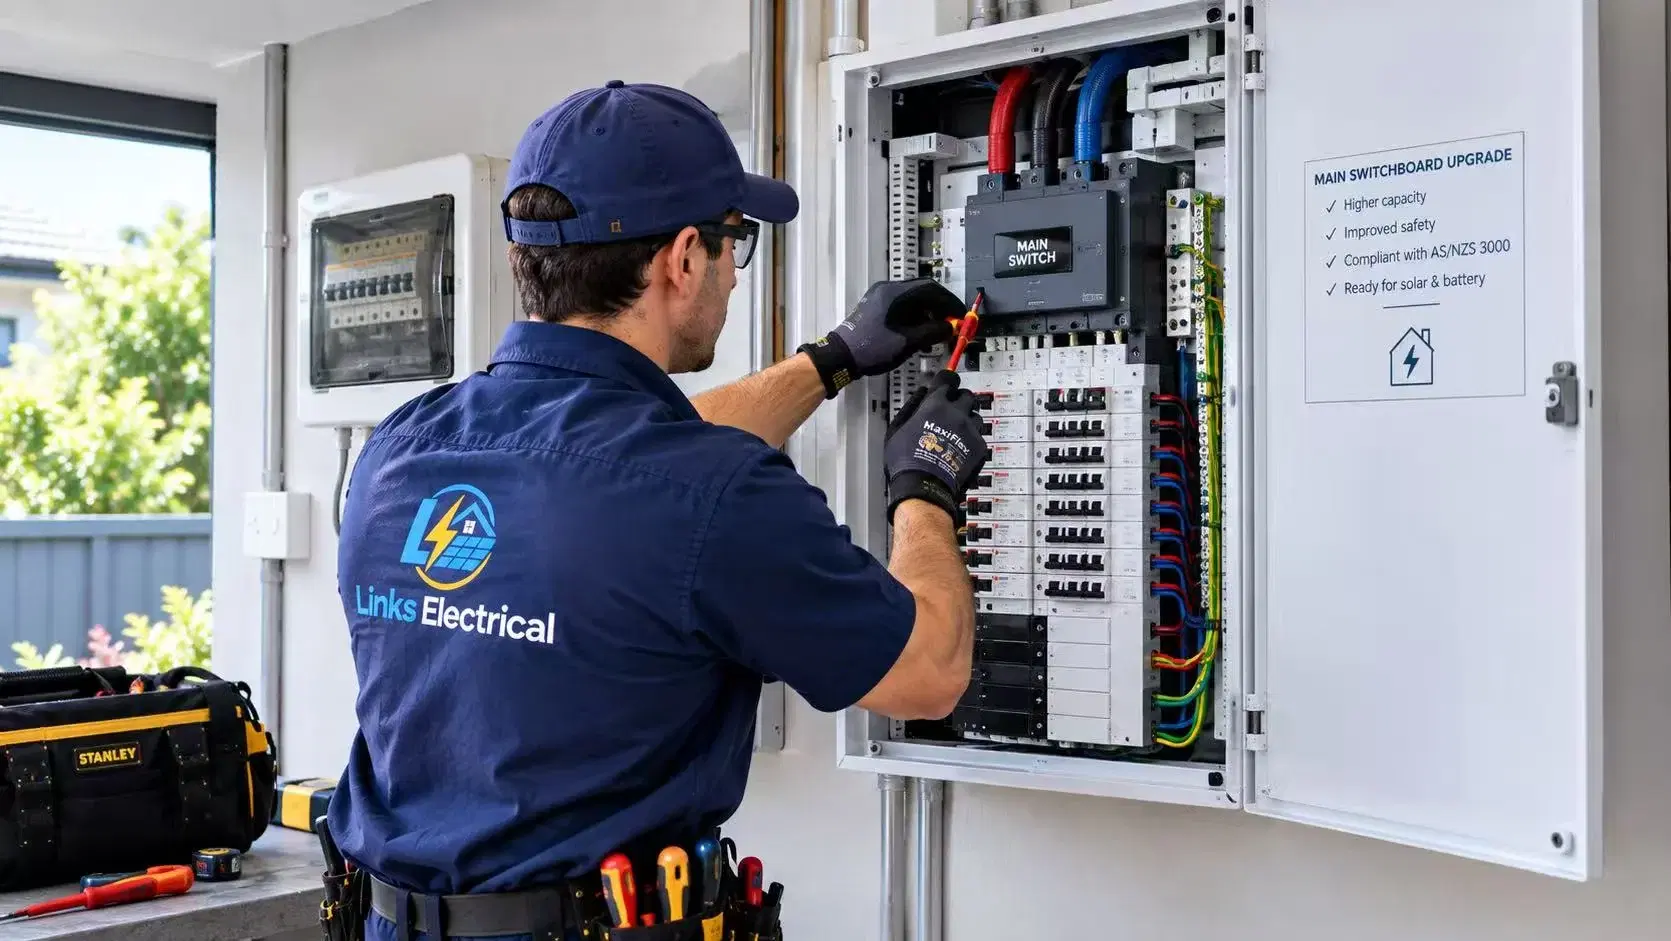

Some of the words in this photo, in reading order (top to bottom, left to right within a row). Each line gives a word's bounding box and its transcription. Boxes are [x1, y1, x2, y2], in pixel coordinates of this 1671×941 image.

[1314, 170, 1346, 186] MAIN
[1349, 157, 1443, 181] SWITCHBOARD
[1447, 148, 1513, 169] UPGRADE
[1344, 196, 1379, 212] Higher
[1382, 191, 1427, 208] capacity
[1344, 221, 1397, 240] Improved
[1401, 218, 1436, 233] safety
[1017, 238, 1048, 252] MAIN
[1344, 250, 1401, 267] Compliant
[1404, 247, 1428, 261] with
[1431, 242, 1476, 259] AS/NZS
[1480, 238, 1511, 255] 3000
[1008, 251, 1056, 267] SWITCH
[1344, 280, 1379, 296] Ready
[1381, 278, 1398, 292] for
[1400, 276, 1428, 291] solar
[1431, 275, 1439, 288] &
[1443, 273, 1486, 287] battery
[923, 420, 970, 456] MaxiFlex
[355, 584, 417, 623] Links
[421, 595, 556, 645] Electrical
[79, 747, 137, 765] STANLEY
